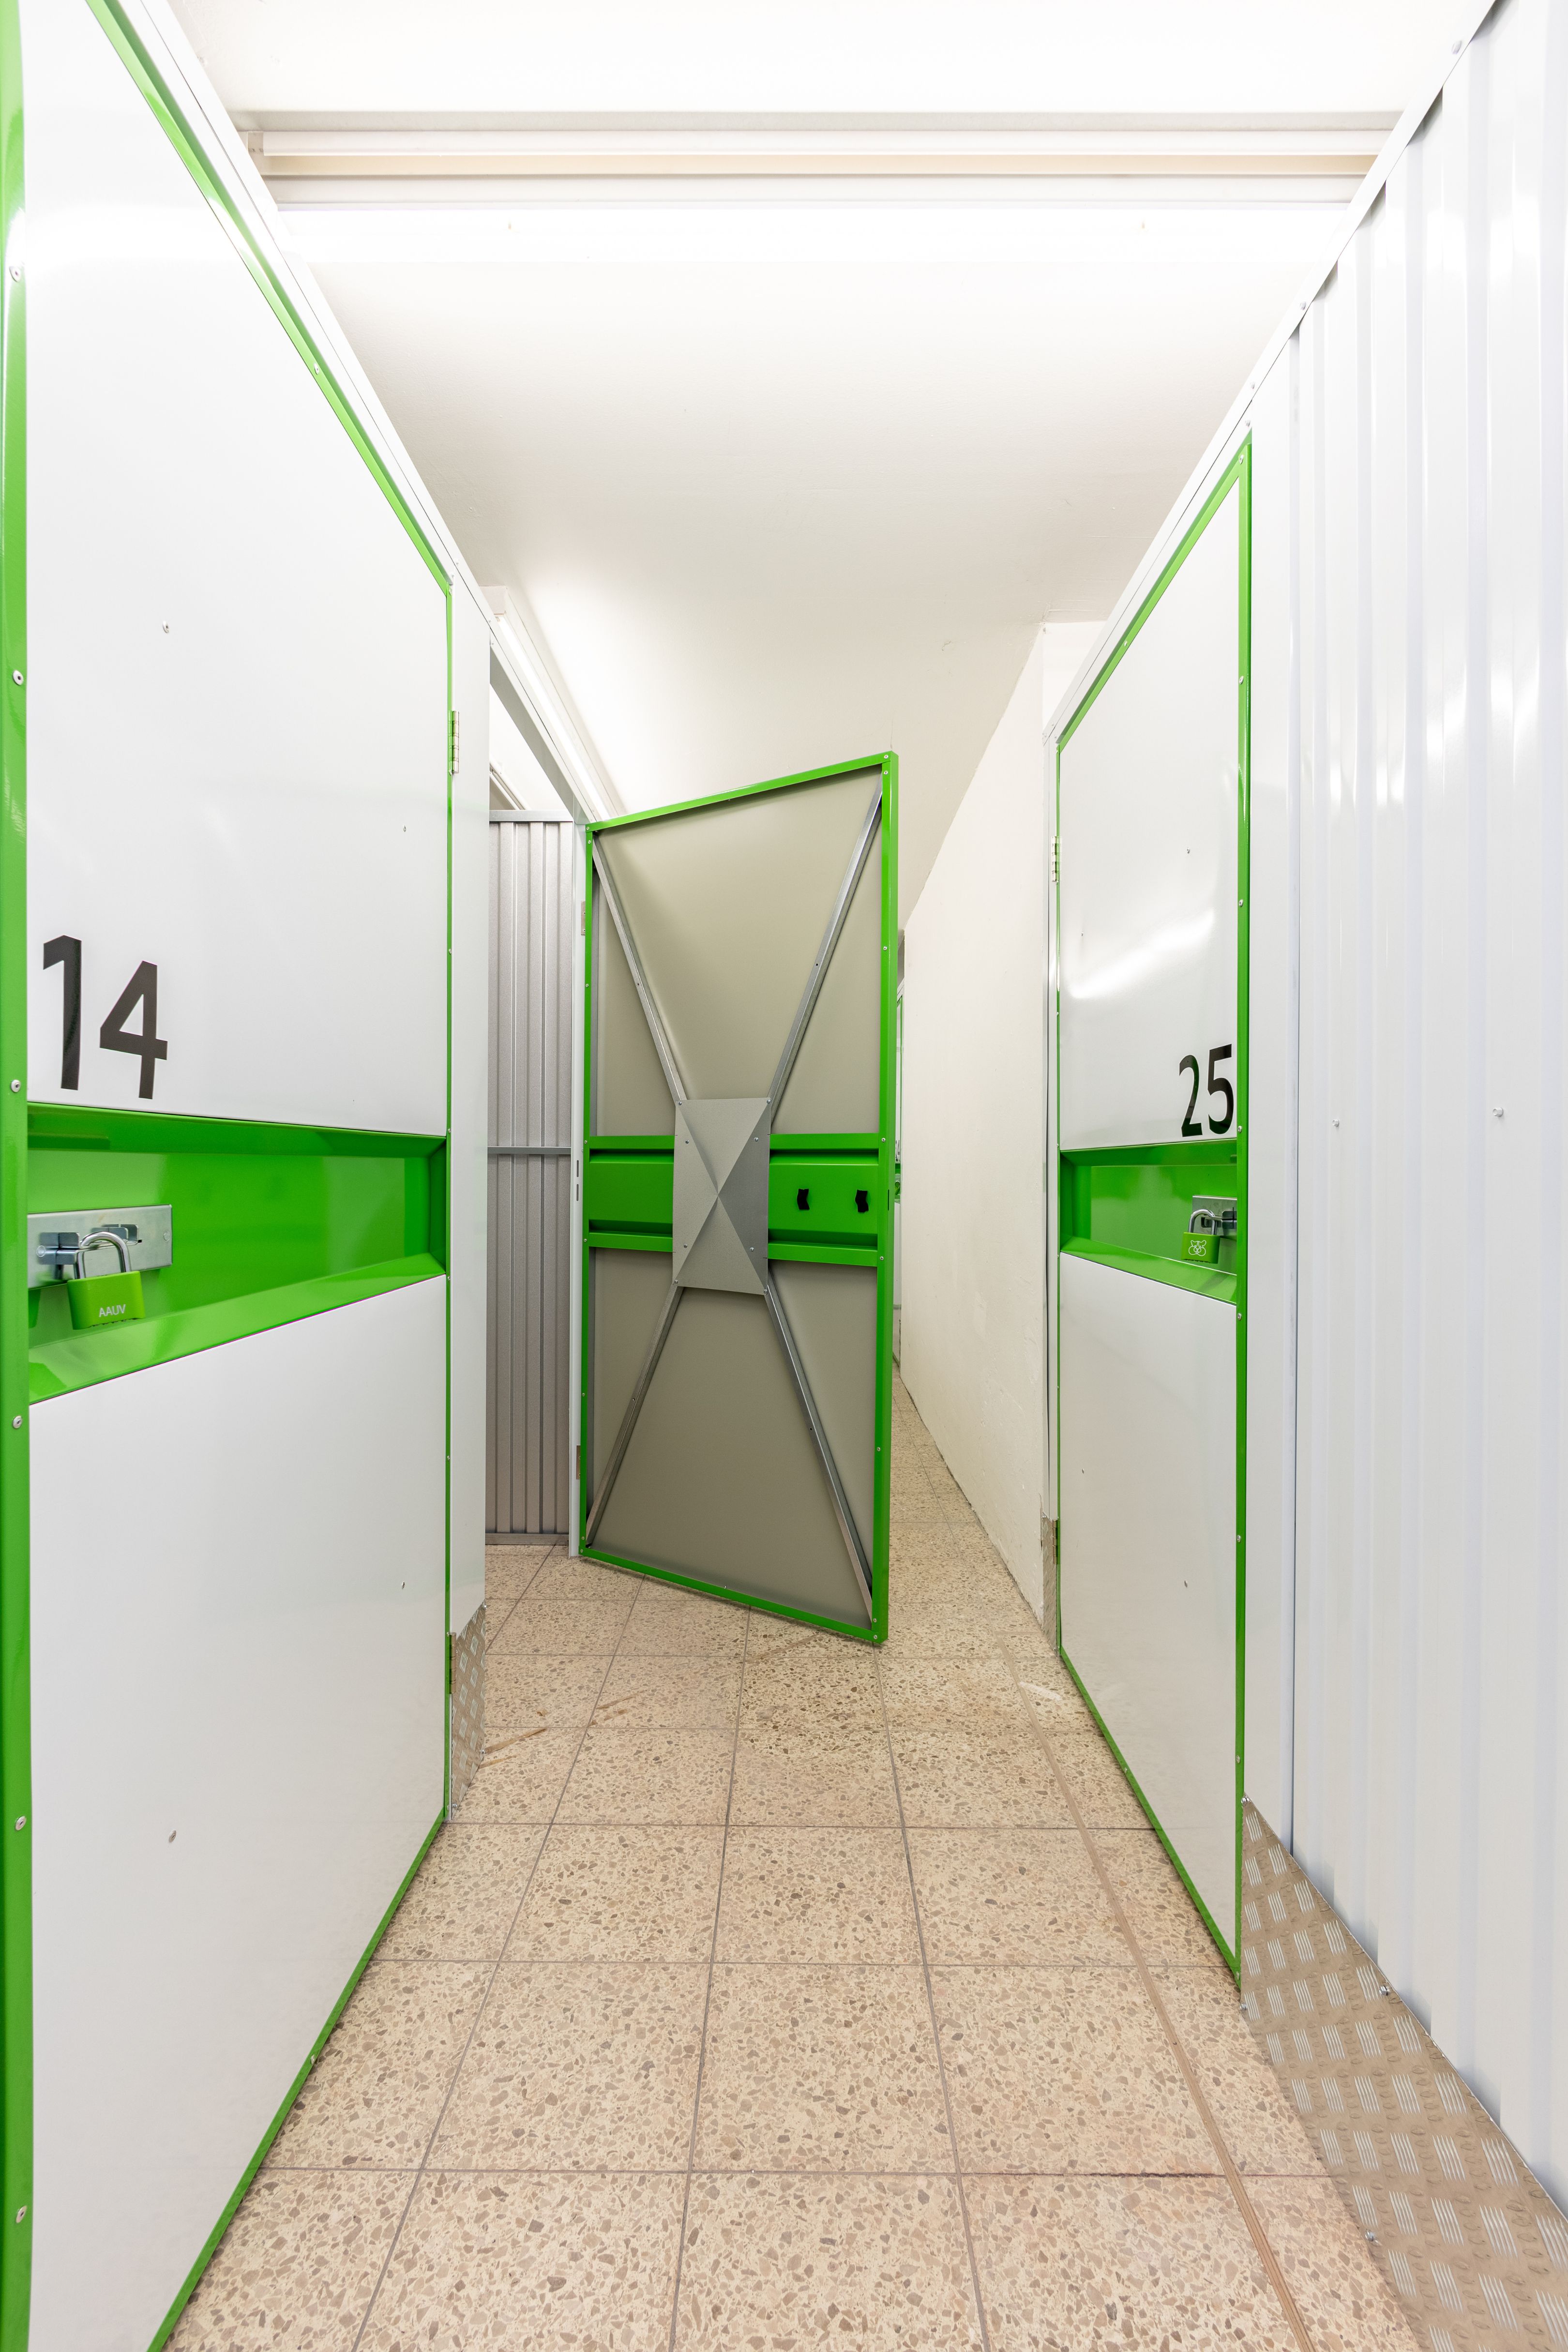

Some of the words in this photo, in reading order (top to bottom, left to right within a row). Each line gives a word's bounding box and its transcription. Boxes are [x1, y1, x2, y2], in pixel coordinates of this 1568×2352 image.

[43, 935, 168, 1100] 14
[1179, 1043, 1234, 1137] 25
[99, 1304, 126, 1317] AAUV
